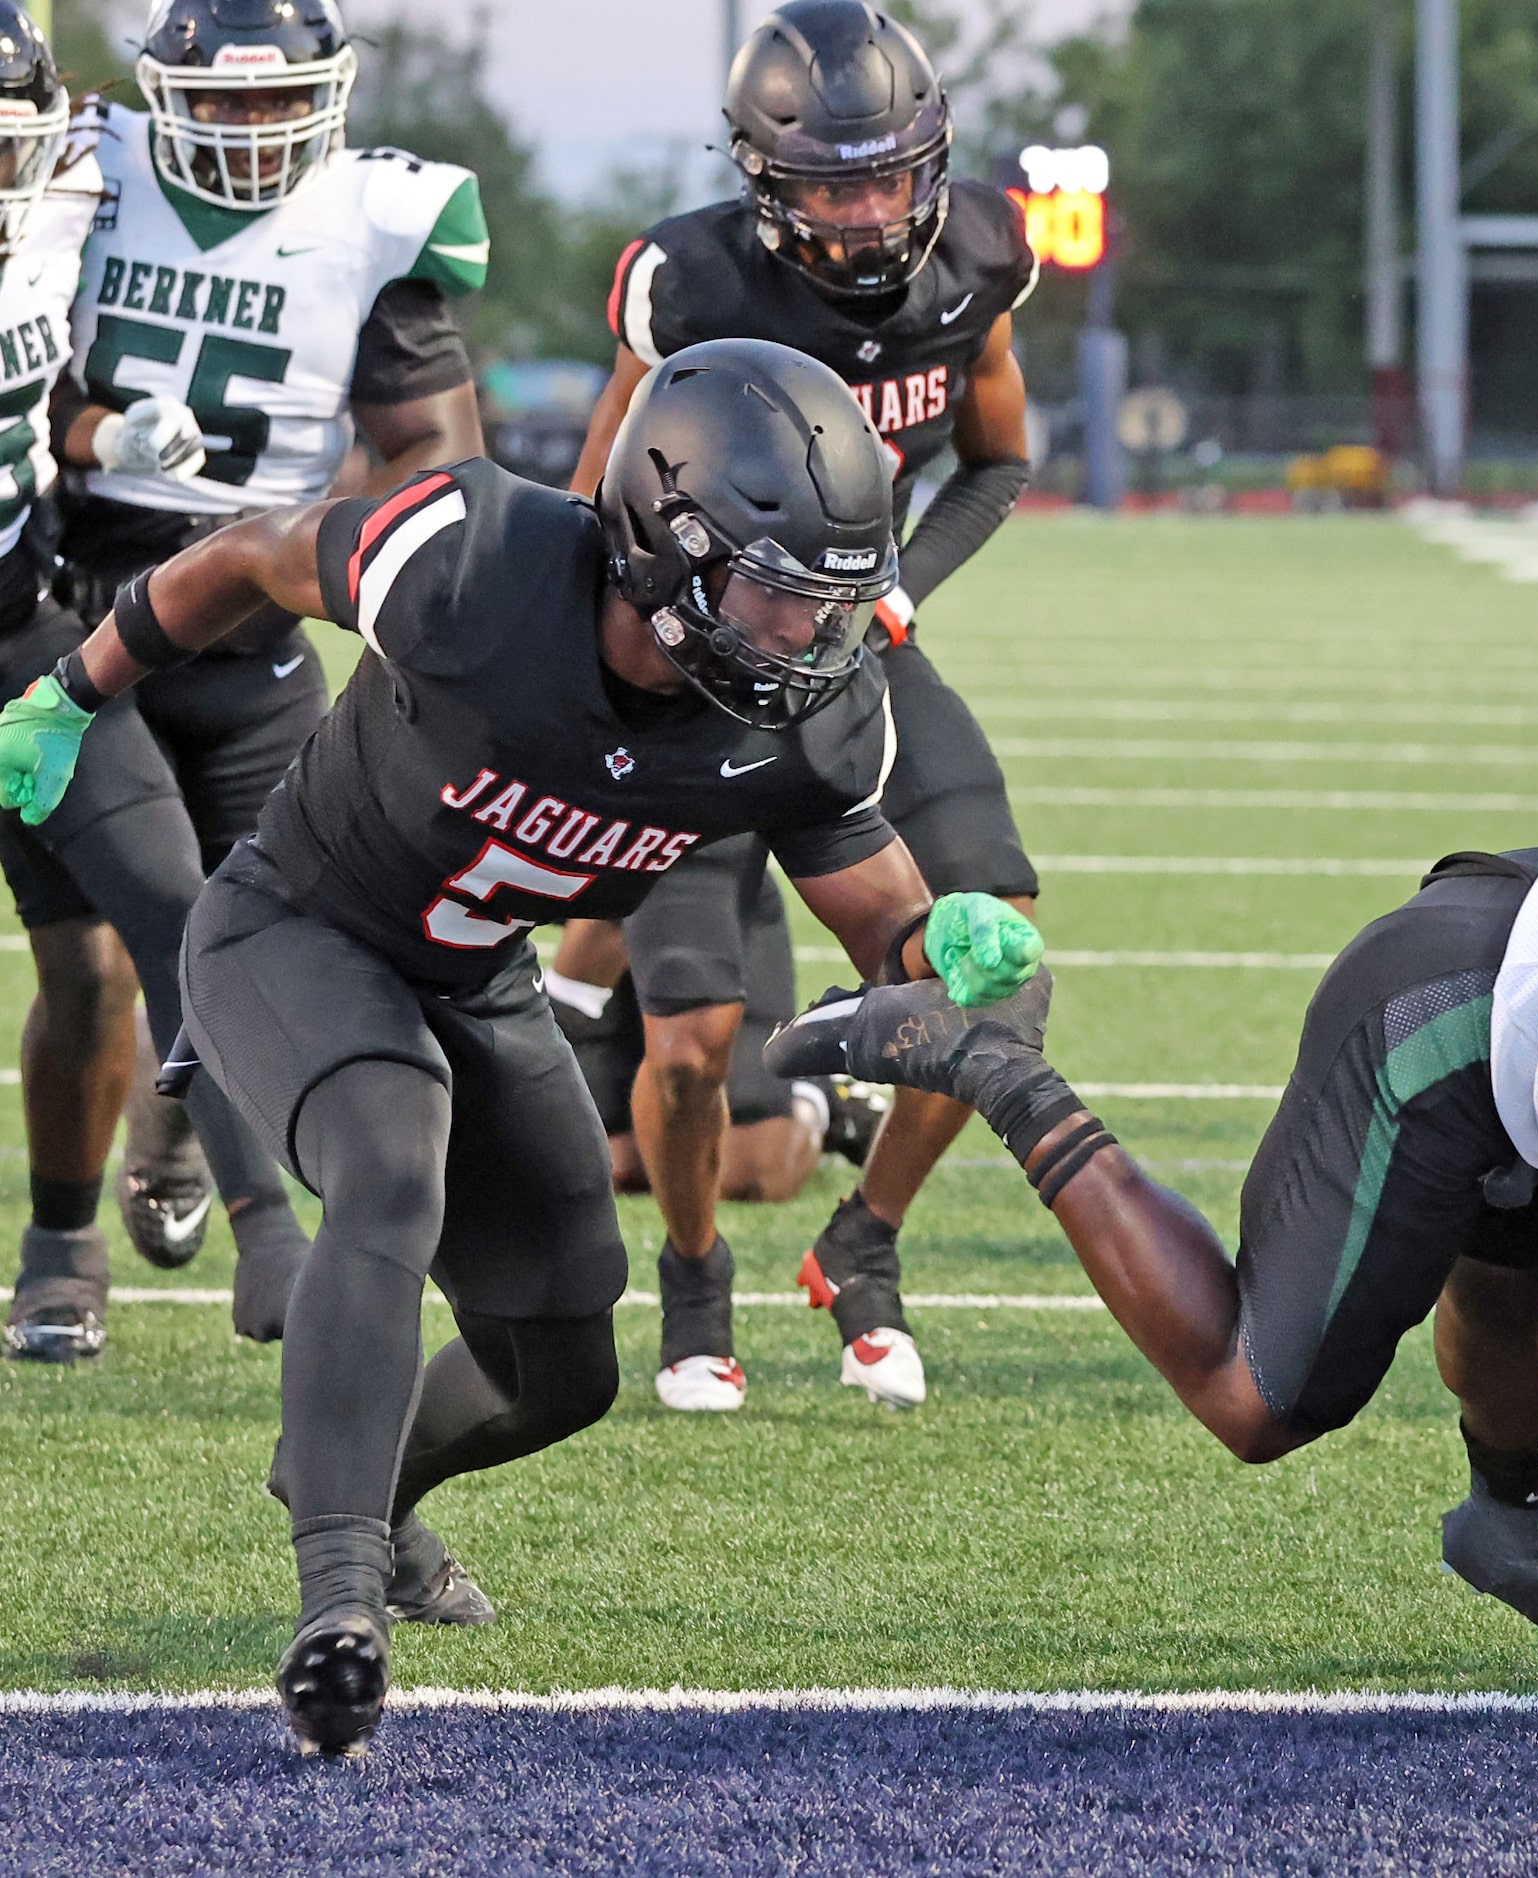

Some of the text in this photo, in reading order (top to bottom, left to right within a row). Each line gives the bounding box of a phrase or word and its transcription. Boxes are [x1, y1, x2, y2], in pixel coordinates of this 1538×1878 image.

[838, 134, 897, 160] Riddell
[97, 256, 287, 335] BERKNER
[84, 313, 294, 488] 55
[823, 552, 878, 571] Riddell
[440, 767, 701, 873] JAGUARS
[420, 836, 598, 949] 5
